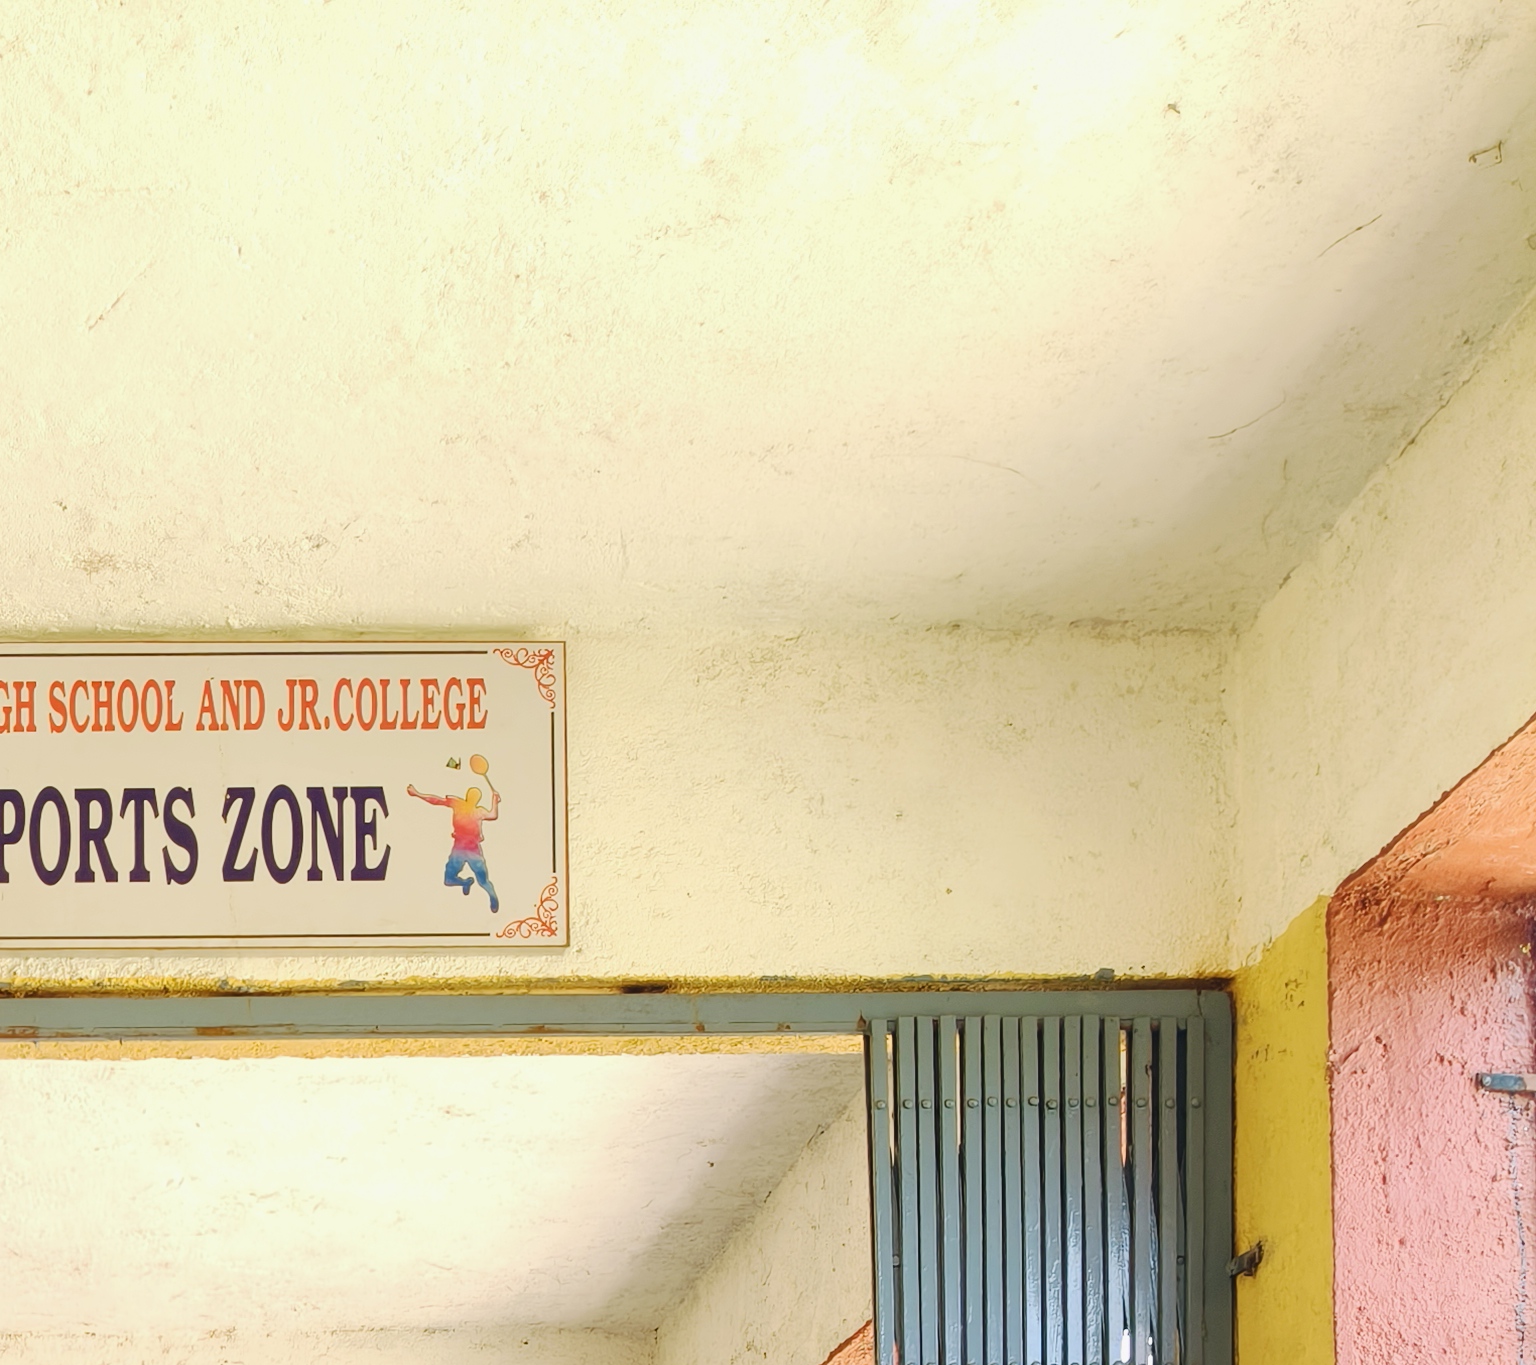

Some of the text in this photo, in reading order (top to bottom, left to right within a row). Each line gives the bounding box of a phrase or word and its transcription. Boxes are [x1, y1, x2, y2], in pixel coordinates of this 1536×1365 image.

[48, 678, 184, 734] SCHOOL
[196, 679, 265, 732] AND
[278, 677, 487, 732] JR.COLLEGE
[222, 784, 391, 884] ZONE
